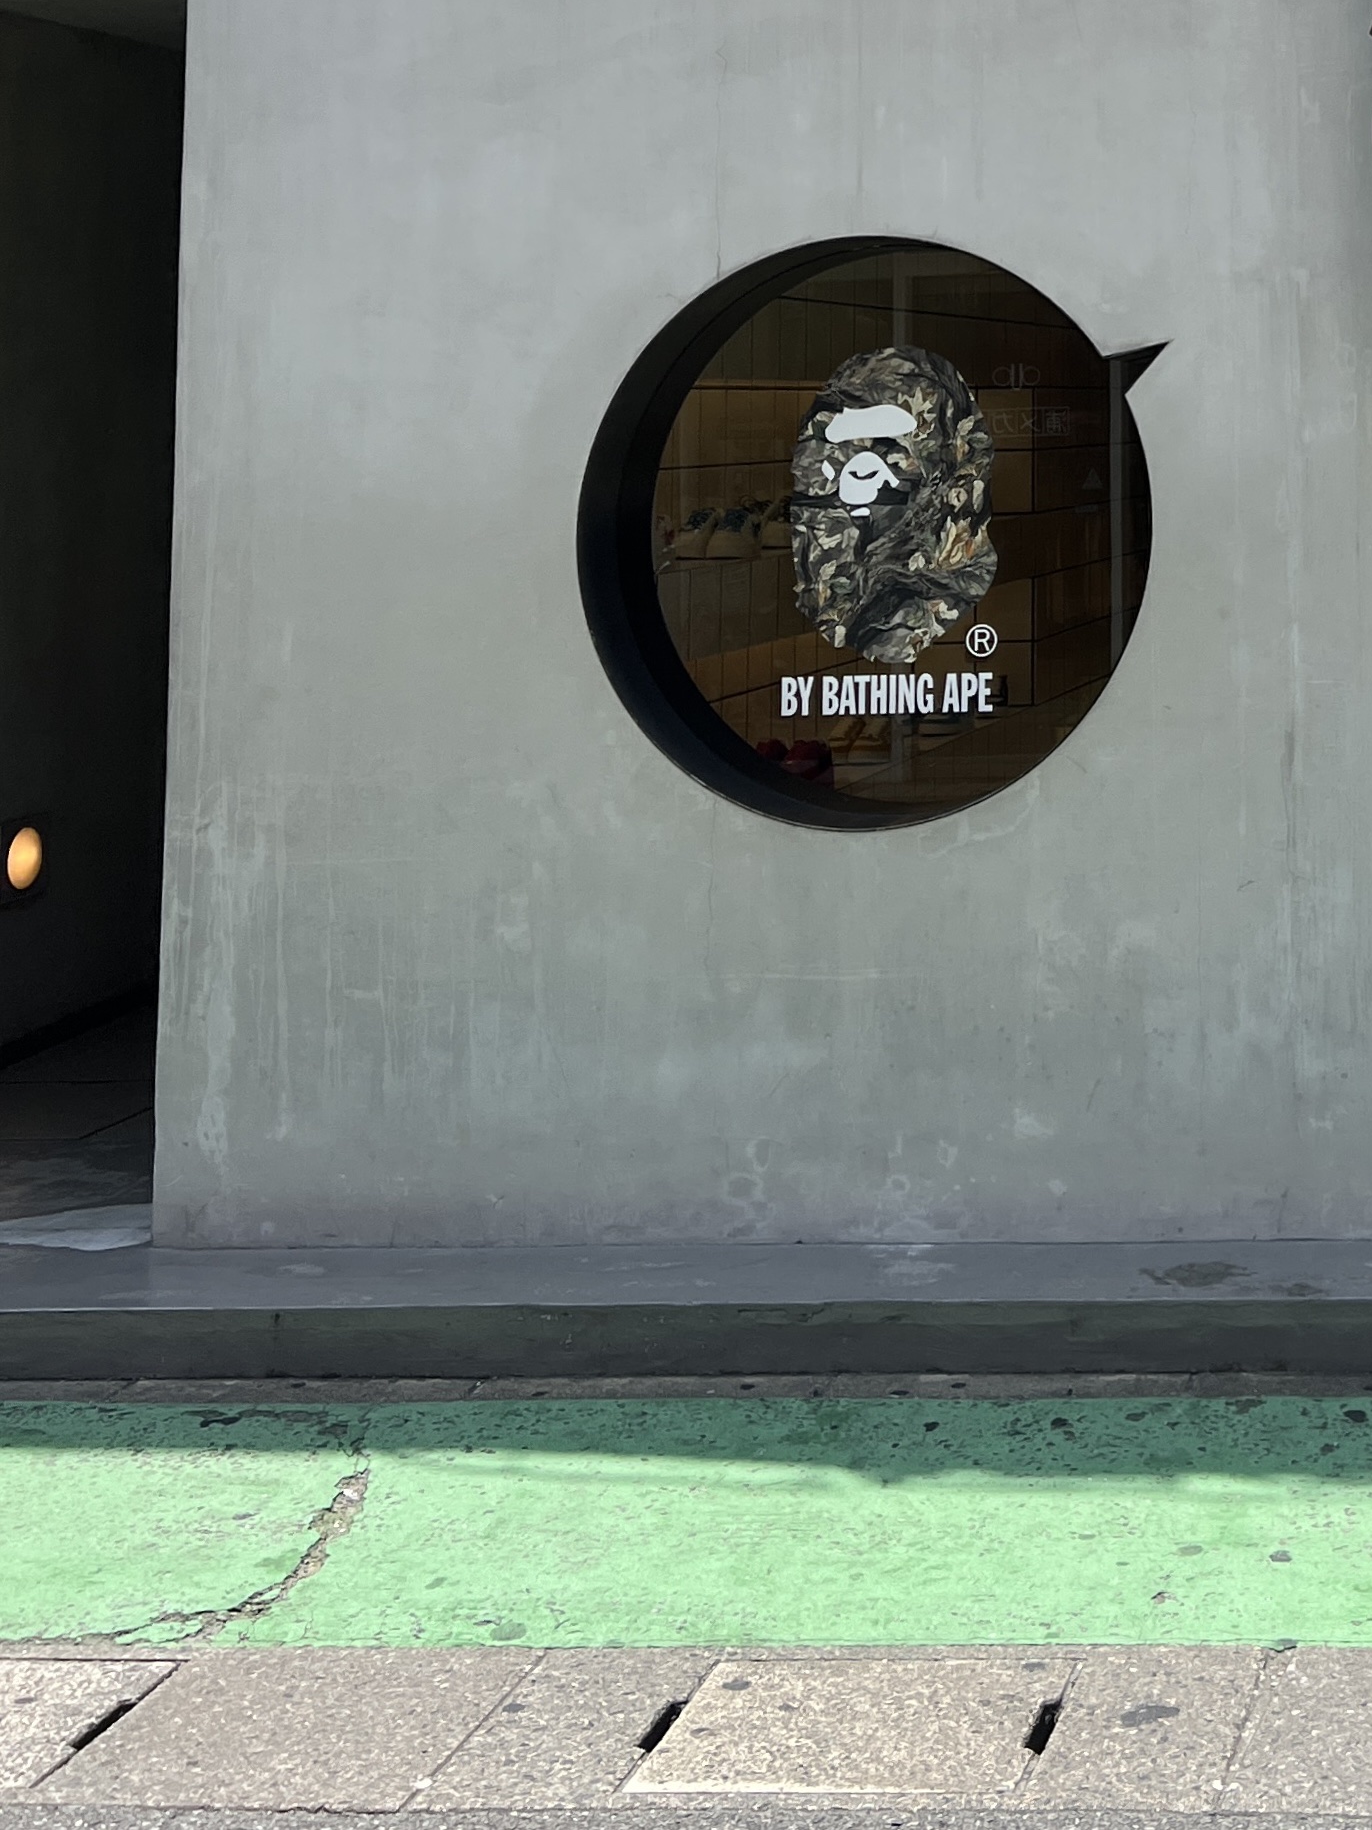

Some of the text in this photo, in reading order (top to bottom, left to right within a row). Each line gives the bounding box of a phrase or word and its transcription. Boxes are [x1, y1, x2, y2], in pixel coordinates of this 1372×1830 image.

[781, 672, 993, 717] BY BATHING APE
